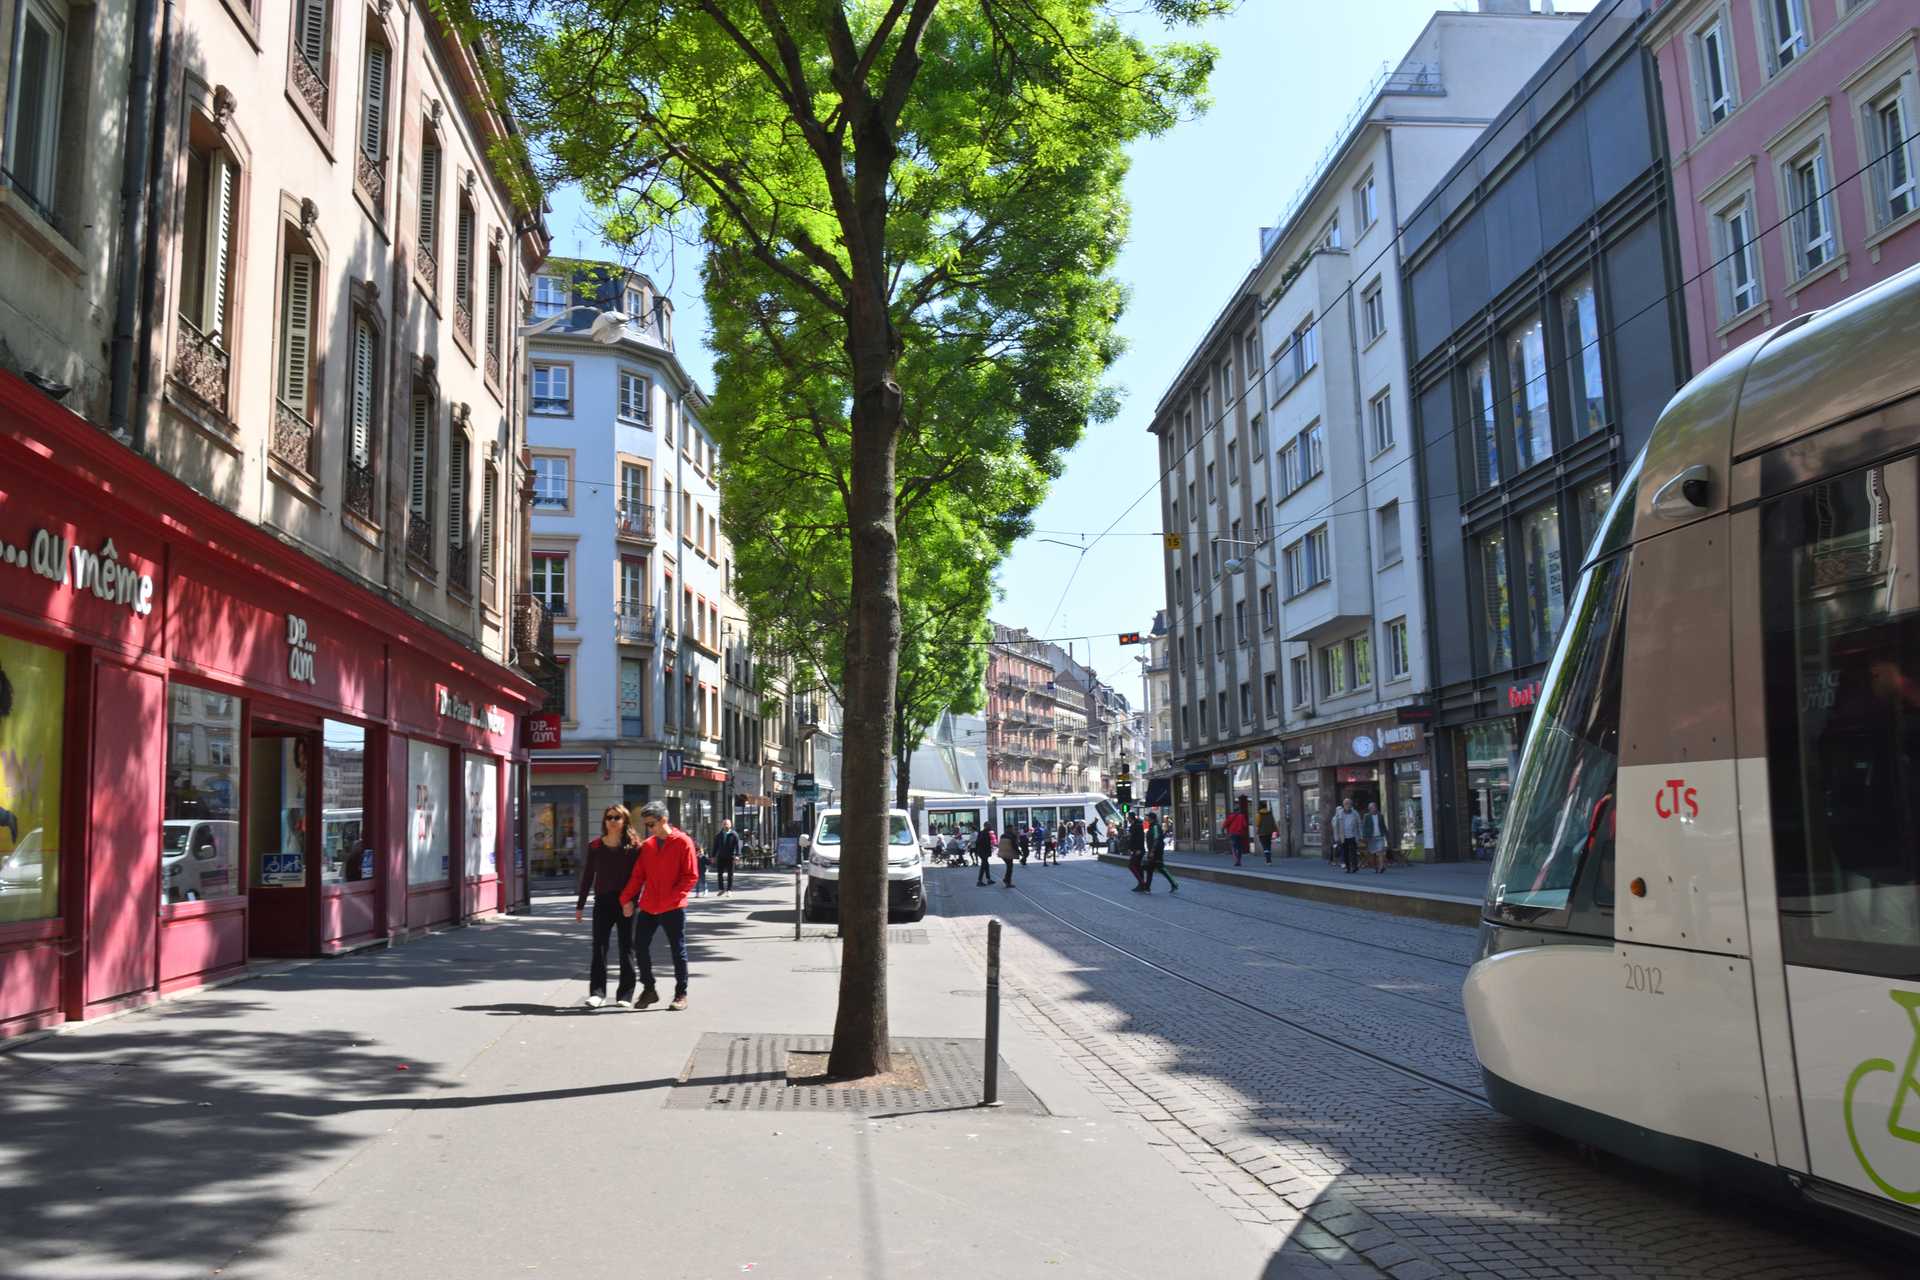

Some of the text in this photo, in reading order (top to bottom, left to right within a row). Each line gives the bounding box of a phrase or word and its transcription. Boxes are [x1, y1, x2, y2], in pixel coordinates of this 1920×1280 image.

[71, 537, 153, 615] même
[290, 647, 317, 685] am
[532, 731, 557, 743] am
[1655, 778, 1699, 819] CTS
[1623, 962, 1665, 996] 2012
